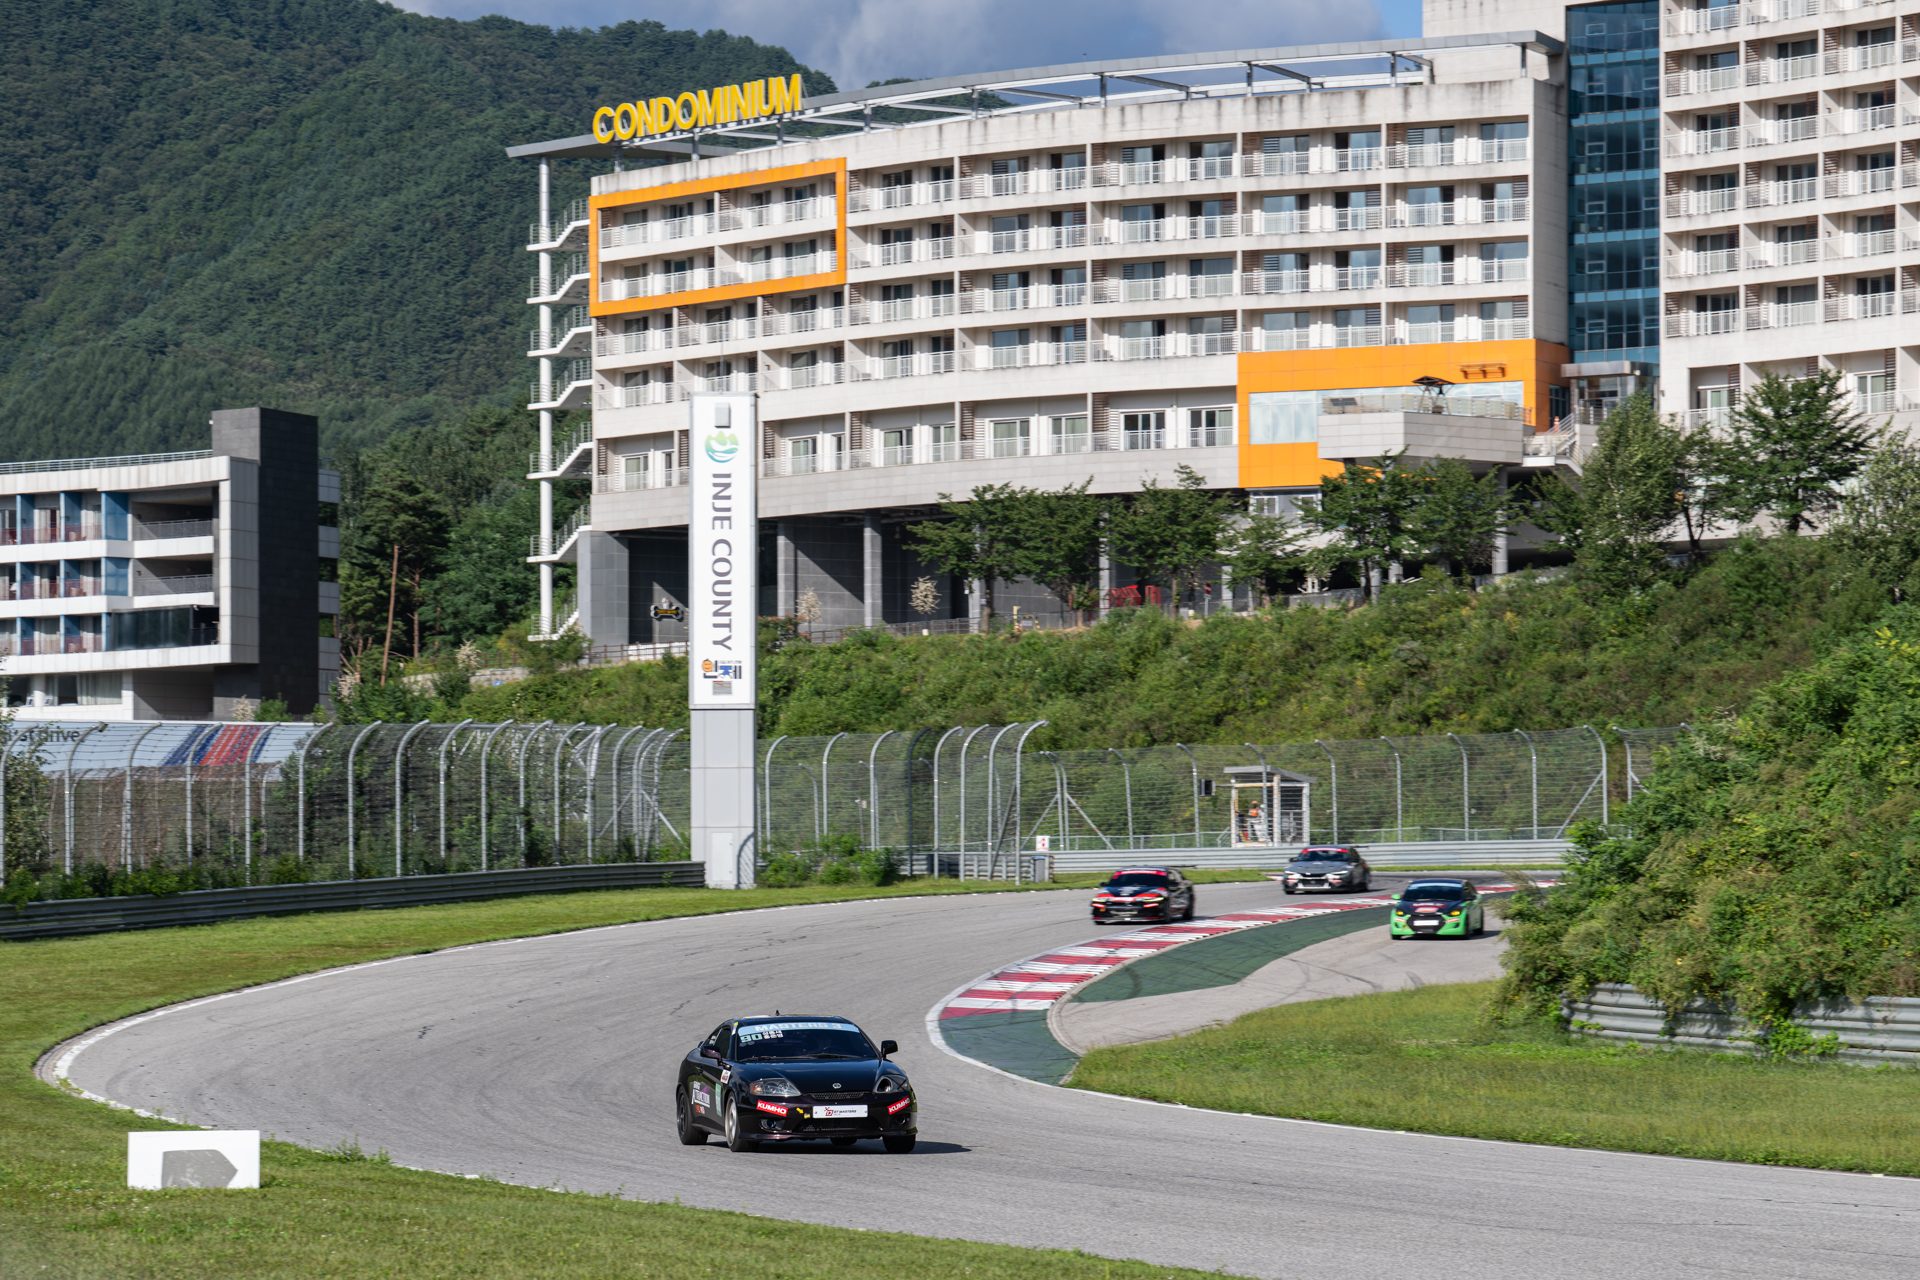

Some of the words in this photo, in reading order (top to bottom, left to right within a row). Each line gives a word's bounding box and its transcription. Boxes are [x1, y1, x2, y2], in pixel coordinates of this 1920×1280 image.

[593, 74, 802, 144] CONDOMINIUM
[712, 473, 732, 530] INJE
[711, 538, 733, 651] COUNTY
[702, 659, 742, 679] 인제
[755, 1023, 829, 1032] MASTERS
[740, 1033, 763, 1043] 90
[757, 1101, 787, 1115] KUMHO
[888, 1096, 911, 1113] KUMHO
